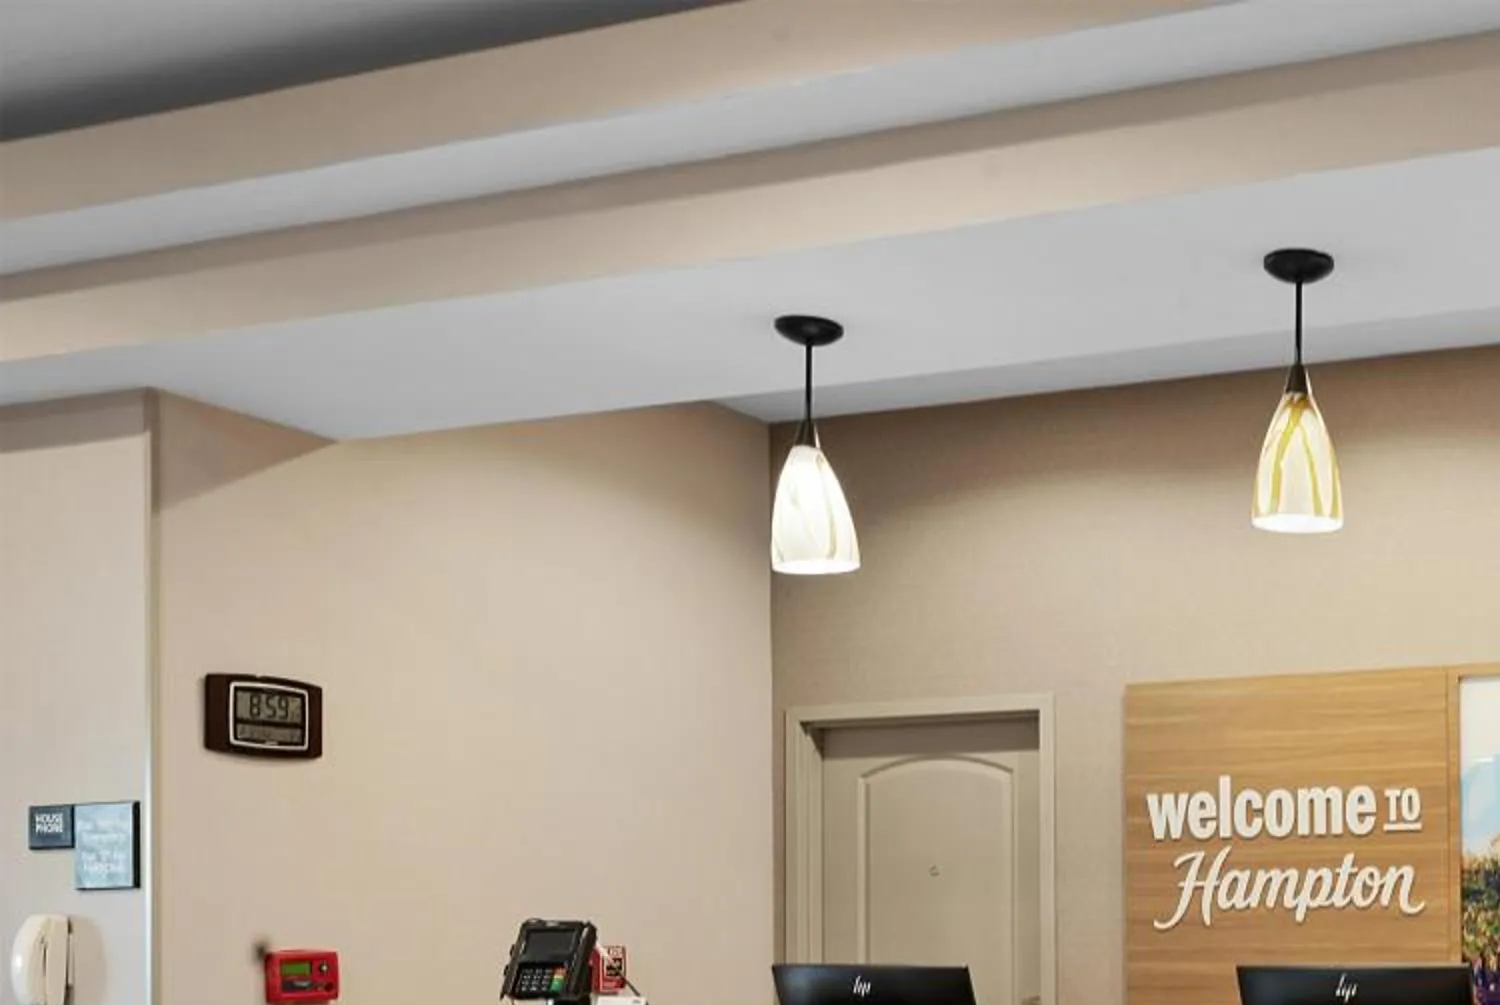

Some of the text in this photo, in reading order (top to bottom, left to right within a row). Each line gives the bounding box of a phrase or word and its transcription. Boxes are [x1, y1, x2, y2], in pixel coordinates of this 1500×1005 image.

[1146, 775, 1422, 840] welcome TO
[1153, 845, 1426, 930] Hampton
